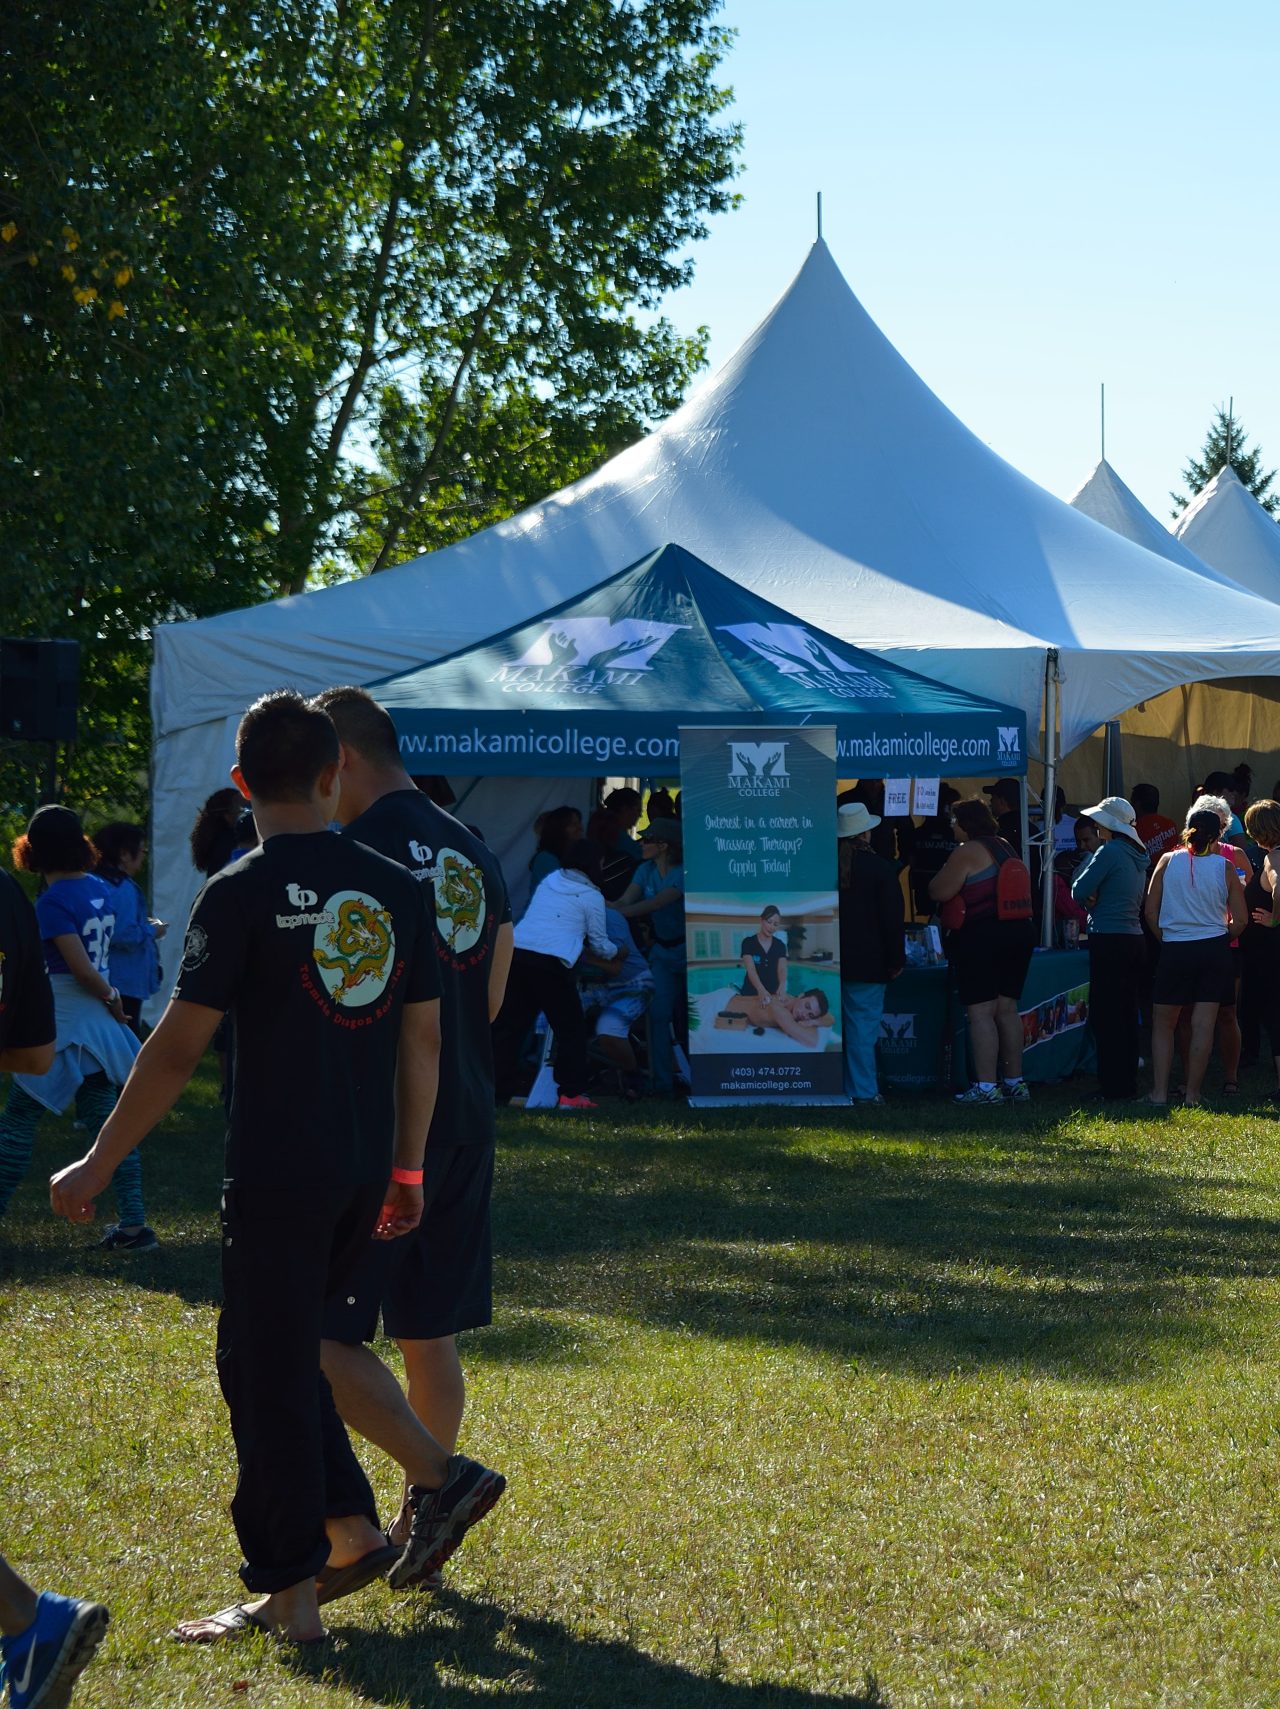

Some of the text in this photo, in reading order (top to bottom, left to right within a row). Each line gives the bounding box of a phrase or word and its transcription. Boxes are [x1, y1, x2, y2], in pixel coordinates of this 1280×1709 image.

[487, 665, 648, 686] MAKAMI
[786, 671, 894, 690] MAKAMI
[501, 681, 607, 695] COLLEGE
[728, 776, 790, 789] MAKAMI
[738, 788, 780, 797] COLLEGE
[888, 793, 907, 804] FREE
[705, 814, 813, 831] Interest in a career in
[714, 836, 803, 855] Massage Therapy?
[728, 858, 791, 878] Apply Today!
[731, 1066, 801, 1078] (403) 474.0772
[721, 1080, 812, 1091] makamicollege.com
